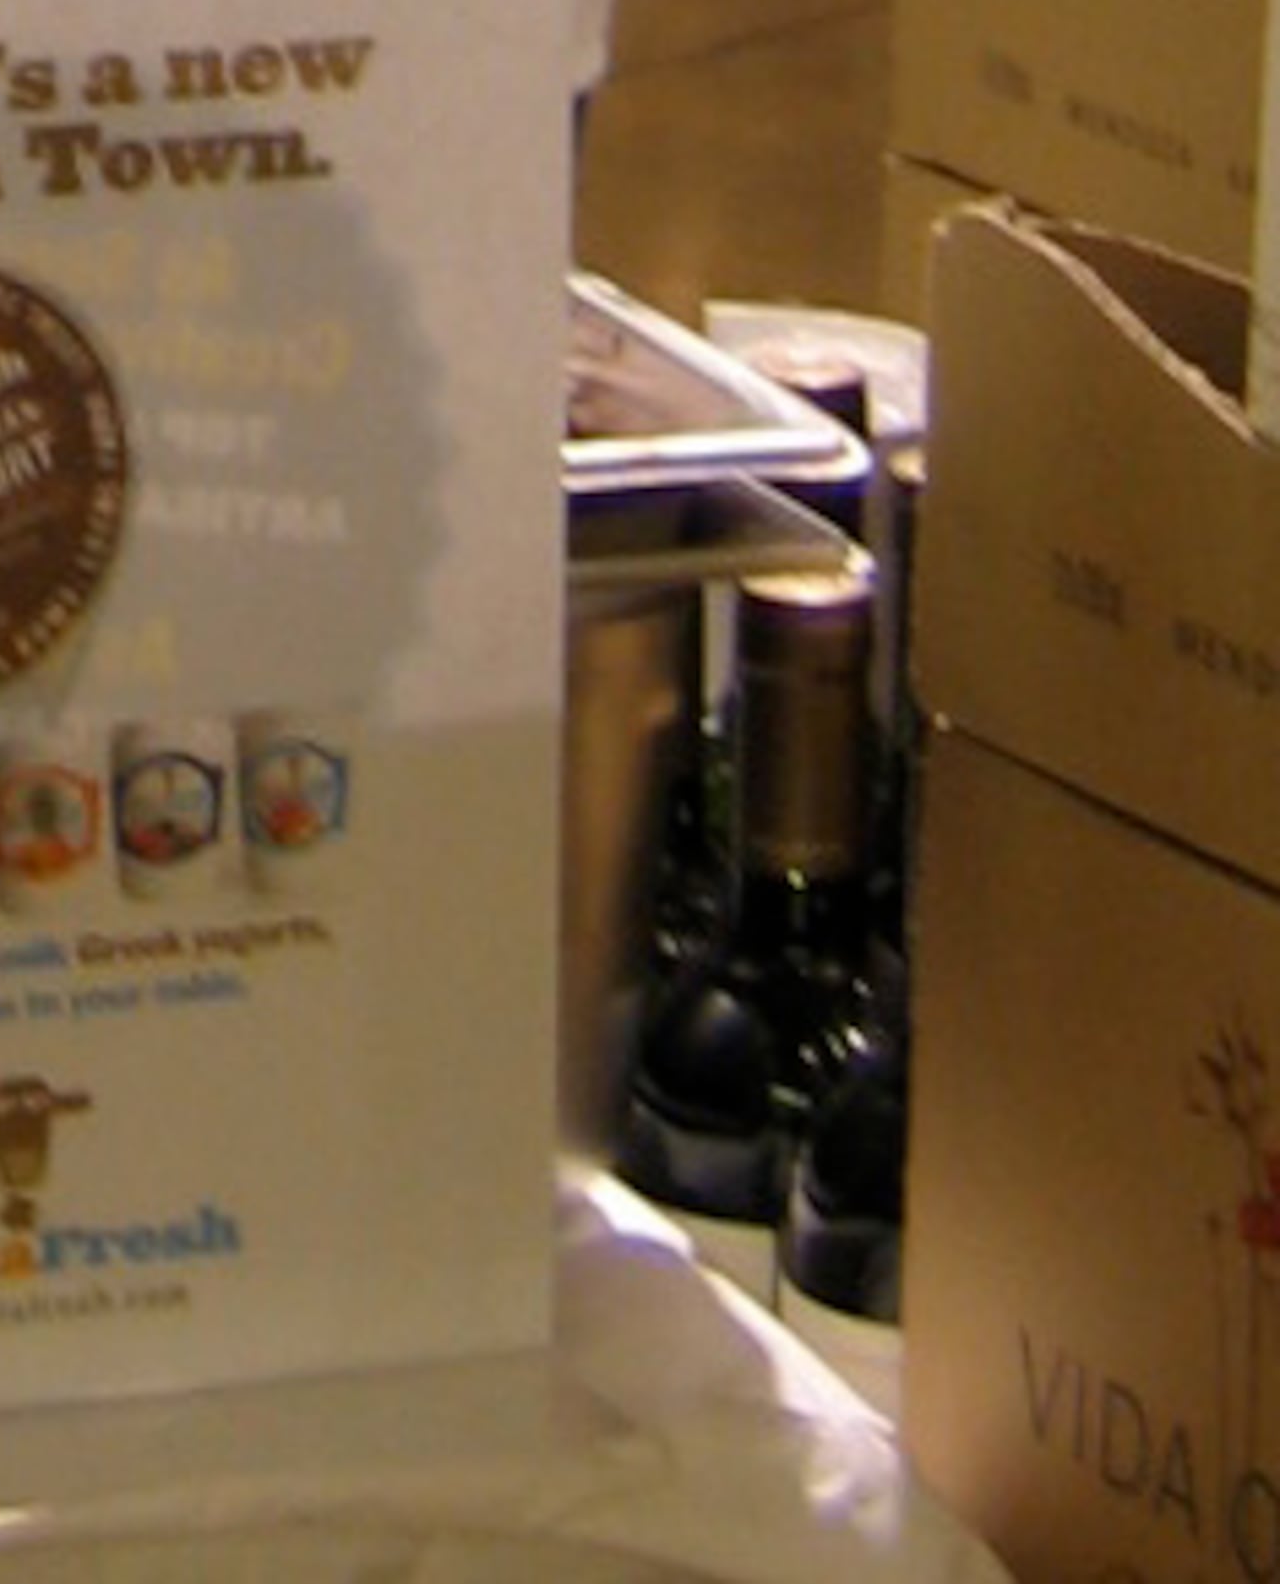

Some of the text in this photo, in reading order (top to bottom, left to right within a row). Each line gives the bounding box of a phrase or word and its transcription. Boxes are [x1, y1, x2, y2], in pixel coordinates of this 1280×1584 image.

[82, 56, 140, 109] a
[163, 36, 376, 100] new
[26, 121, 334, 199] Town.
[1018, 1320, 1200, 1539] VIDA
